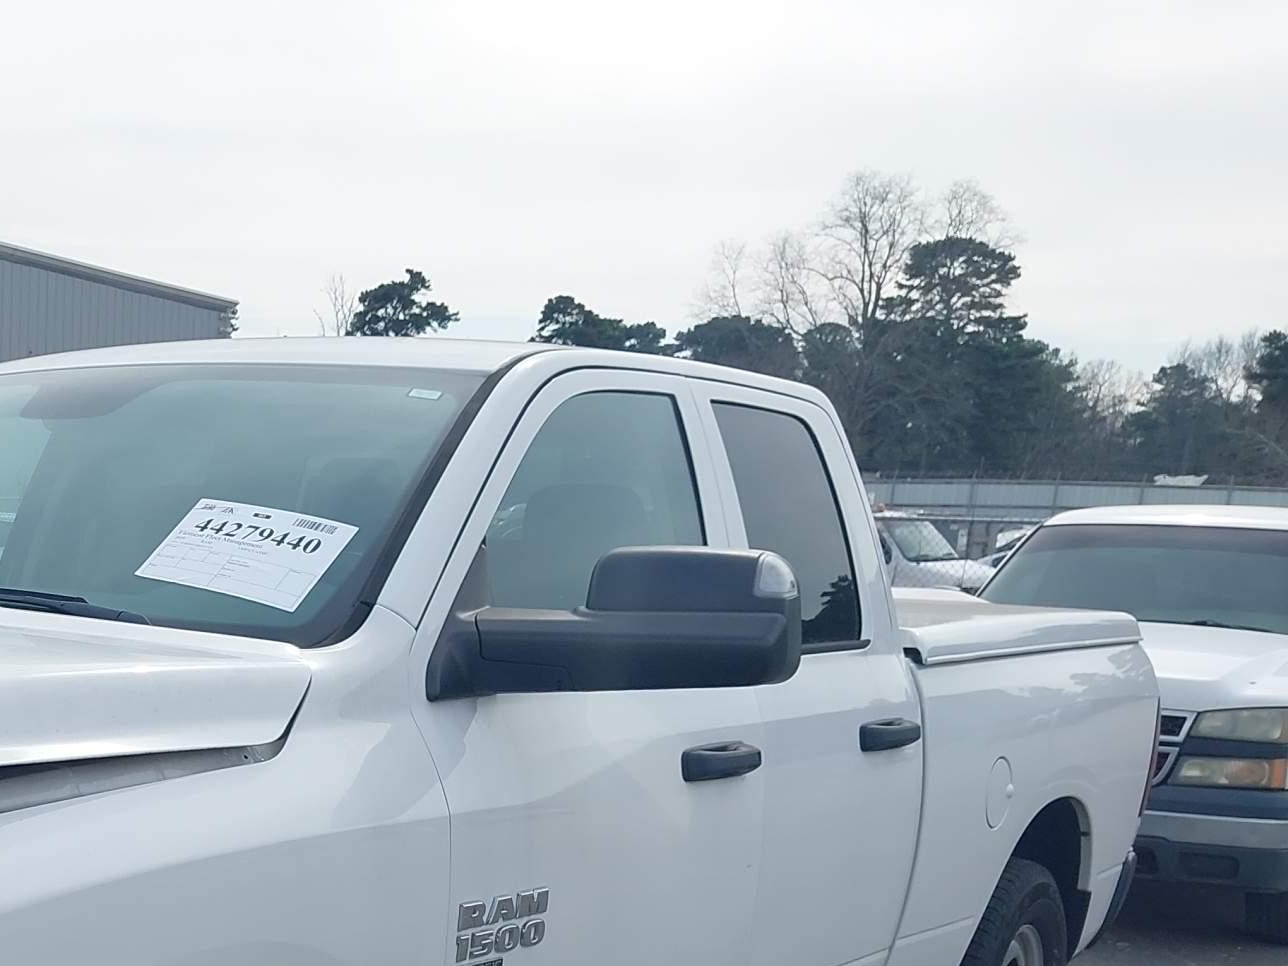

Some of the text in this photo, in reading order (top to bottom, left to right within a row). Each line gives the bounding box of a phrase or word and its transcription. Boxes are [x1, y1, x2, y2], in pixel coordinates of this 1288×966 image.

[194, 518, 322, 554] 44279440
[457, 886, 550, 932] RAM
[455, 918, 546, 963] 1500
